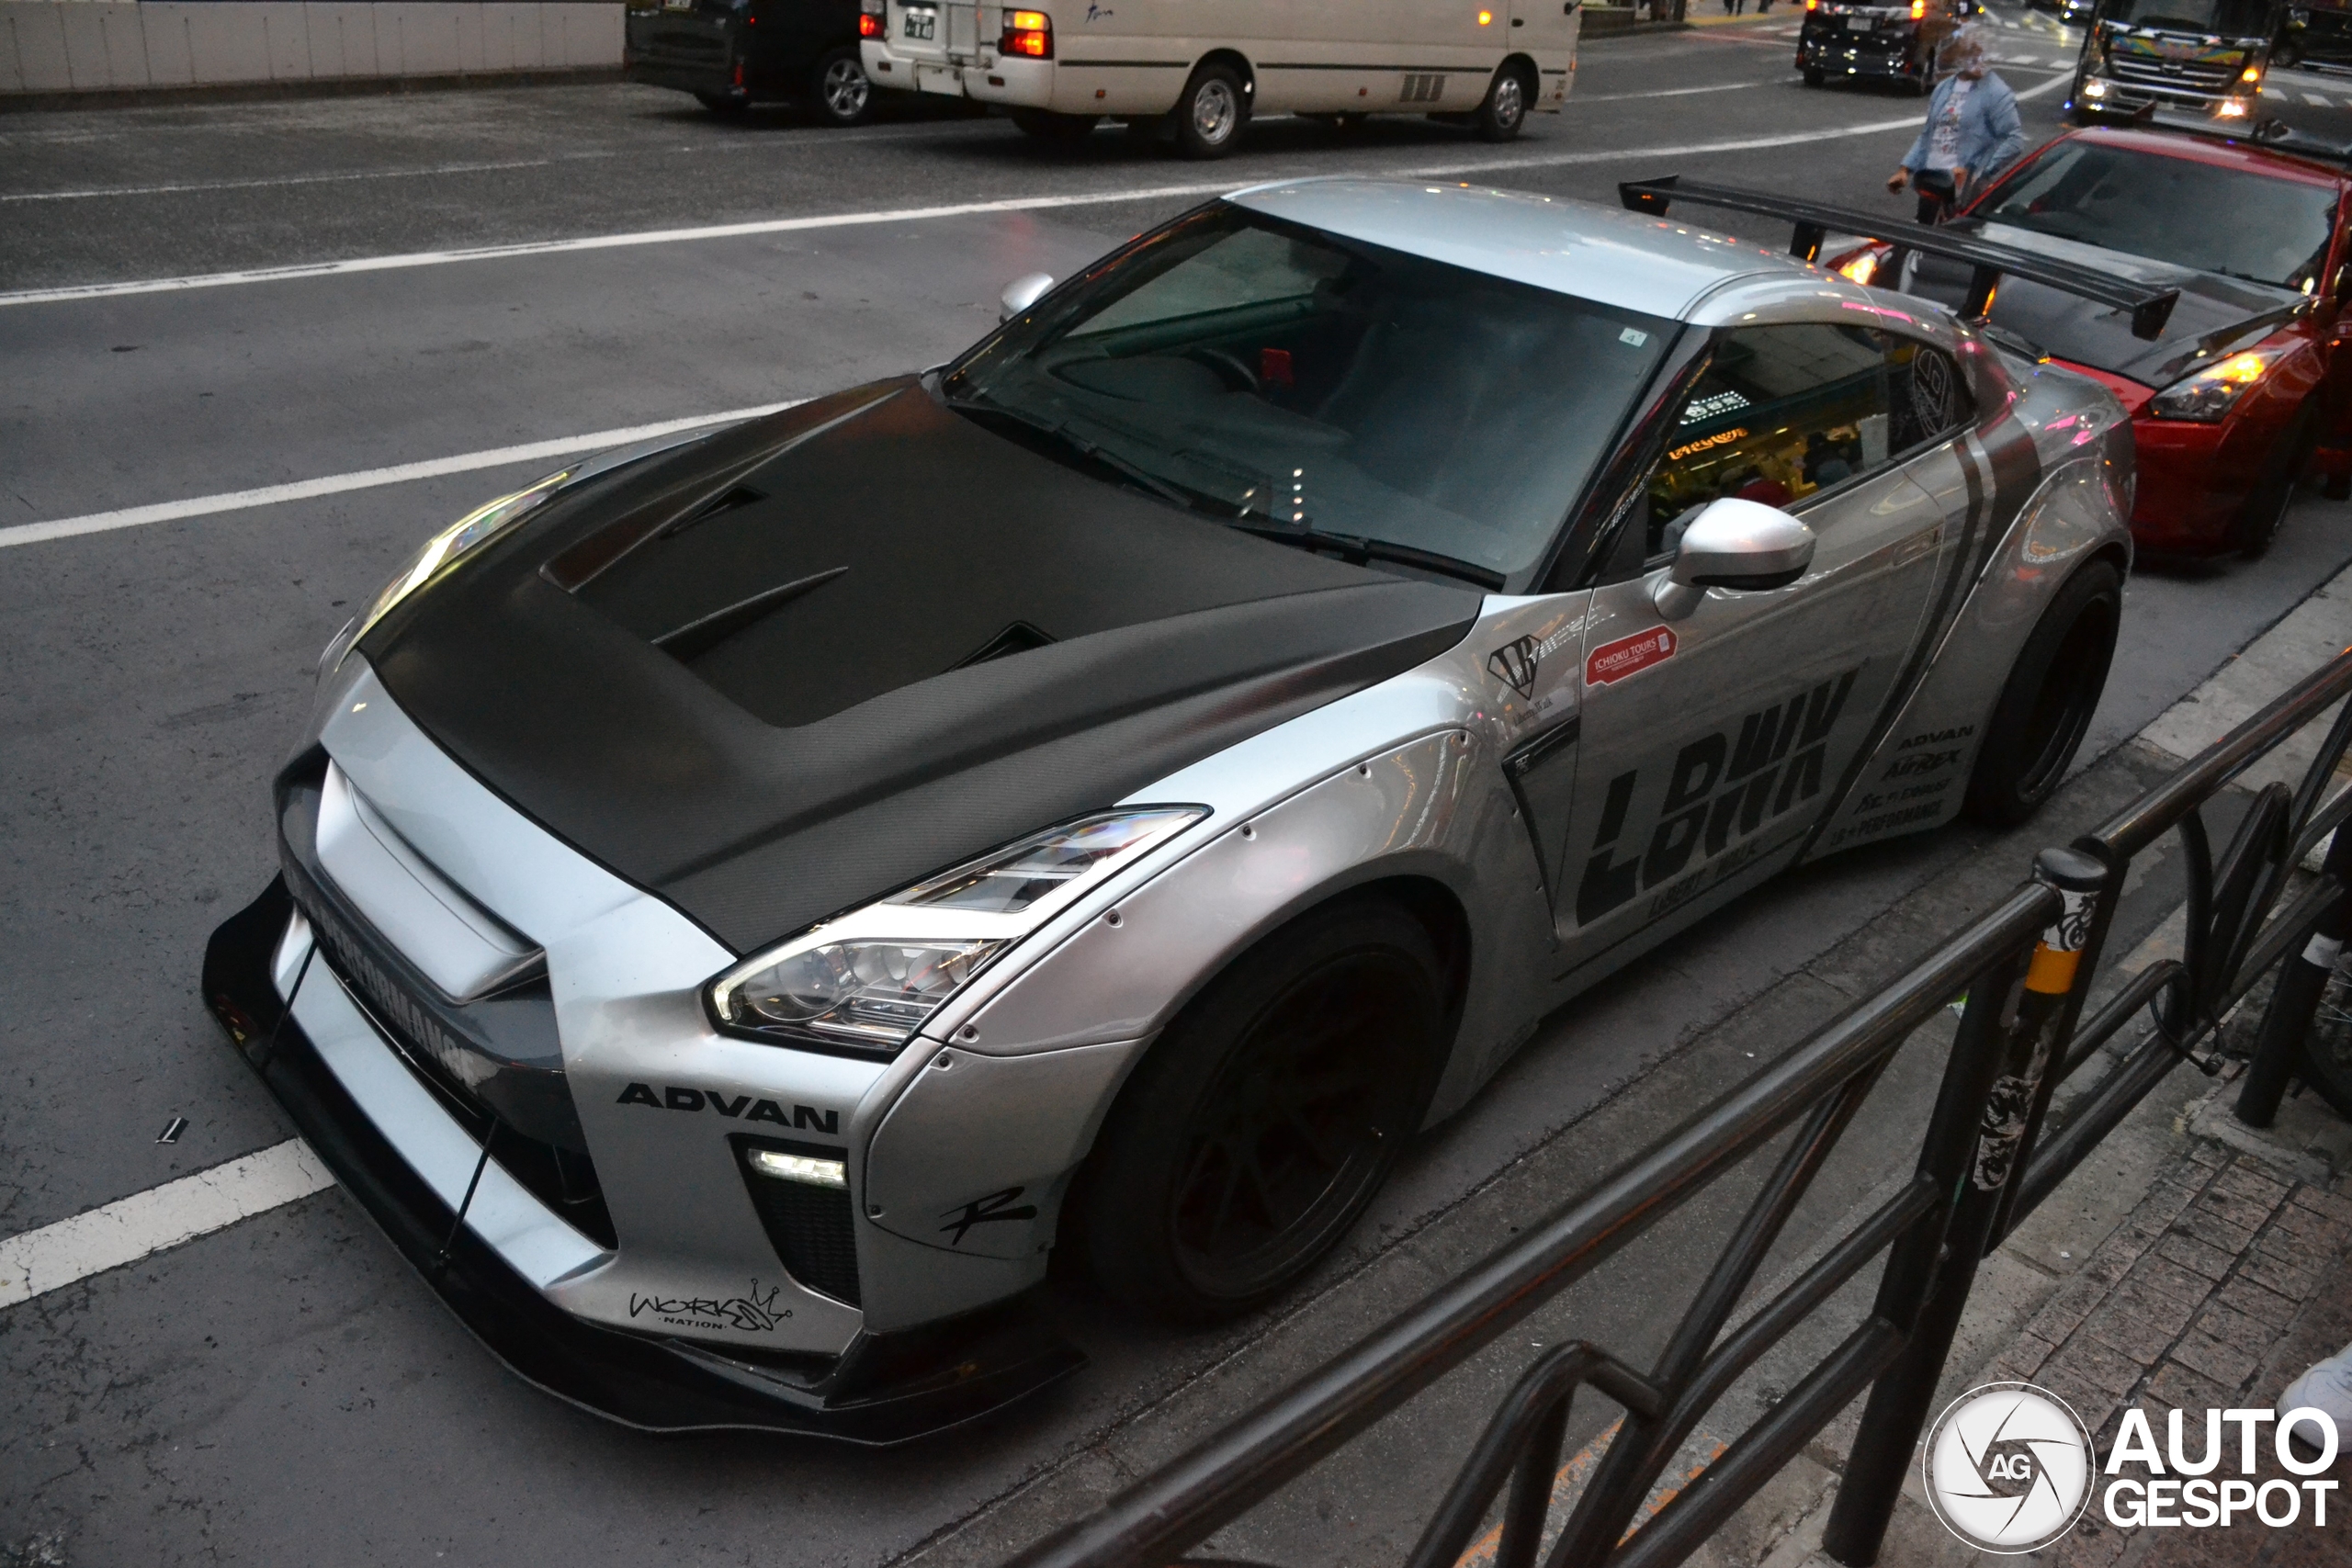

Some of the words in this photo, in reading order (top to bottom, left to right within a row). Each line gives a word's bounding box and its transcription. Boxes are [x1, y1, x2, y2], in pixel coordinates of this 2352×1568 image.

[1594, 649, 1630, 671] ICHIOKU
[1629, 637, 1657, 657] TOURS
[1895, 725, 1974, 751] ADVAN
[616, 1082, 839, 1135] ADVAN
